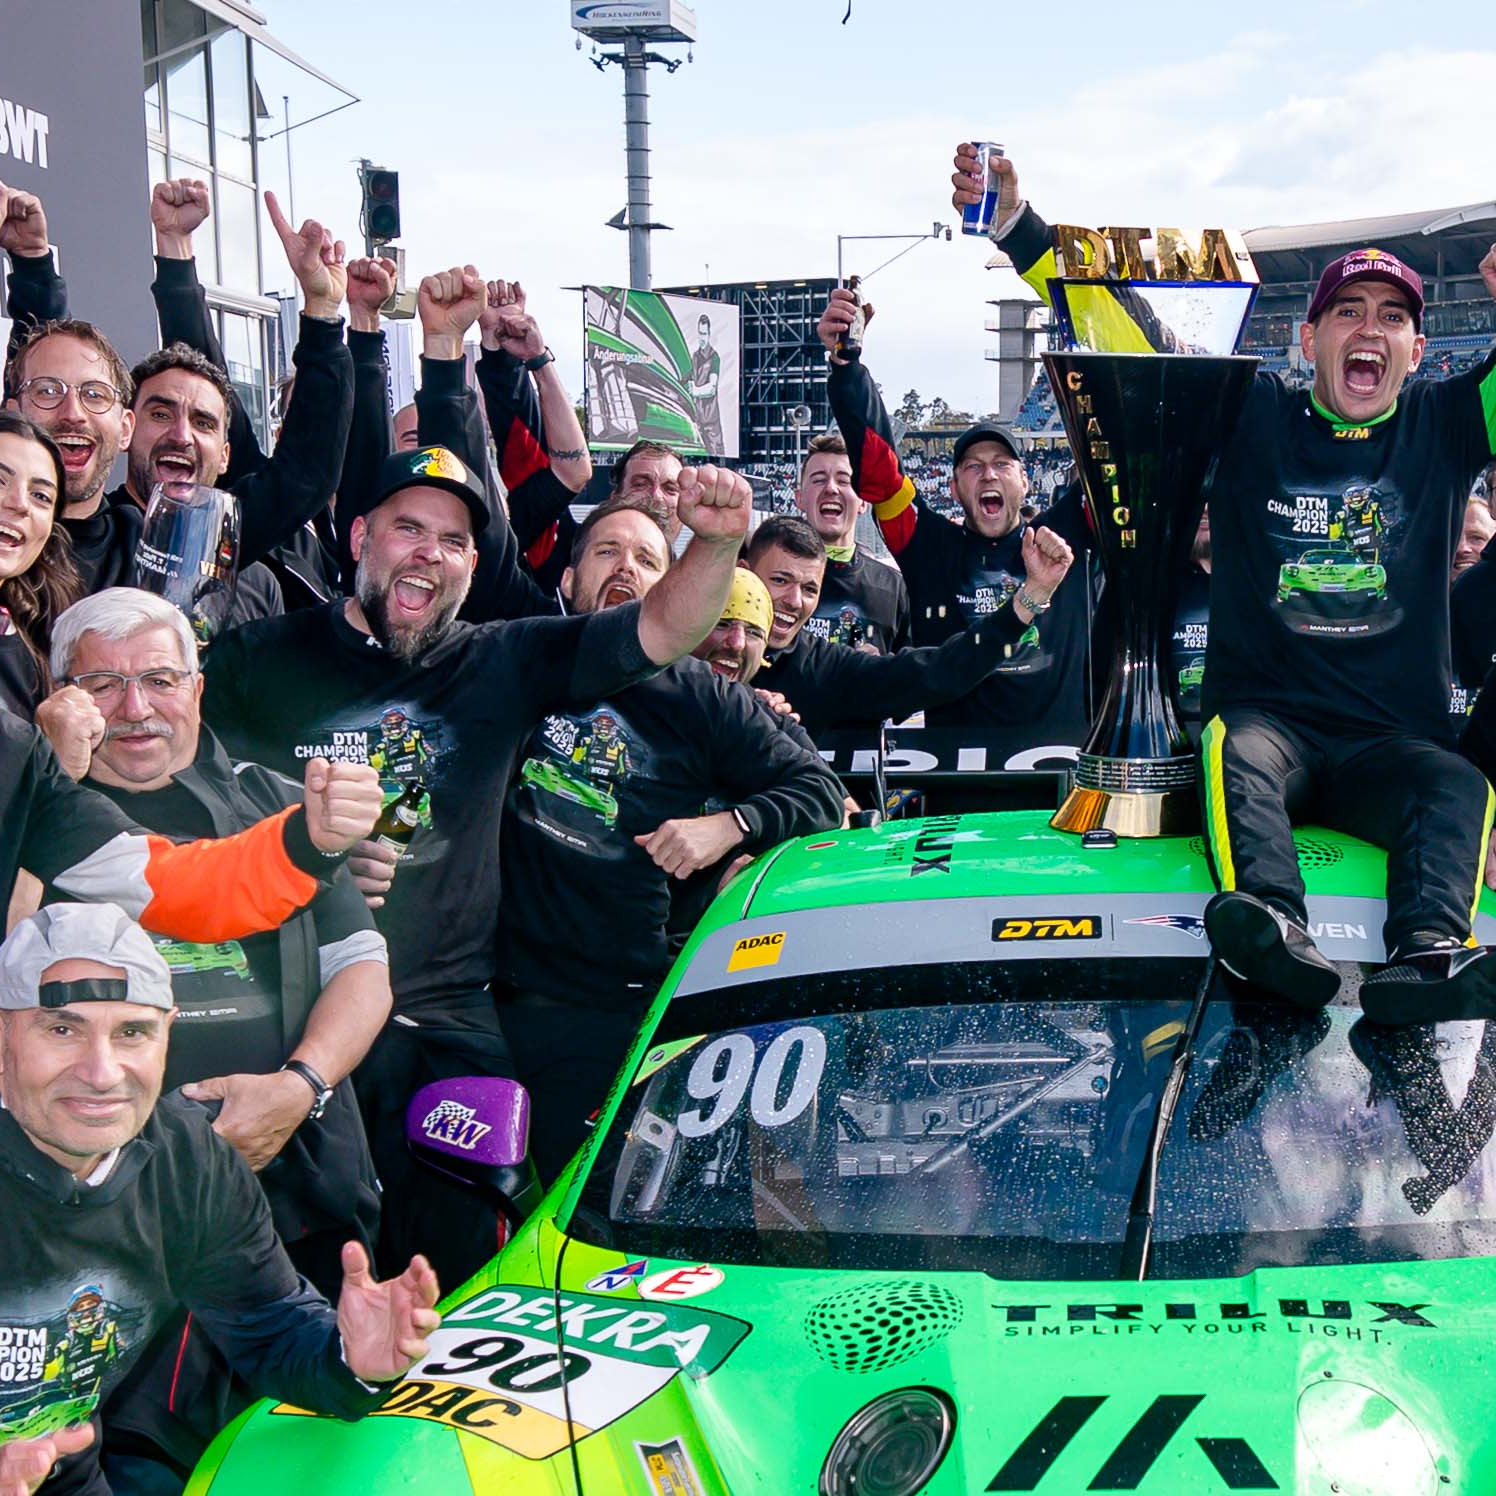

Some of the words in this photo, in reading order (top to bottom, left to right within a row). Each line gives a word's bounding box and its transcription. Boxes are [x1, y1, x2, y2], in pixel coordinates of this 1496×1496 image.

[1055, 223, 1248, 283] DTM
[1267, 499, 1328, 522] CHAMPION
[1295, 496, 1328, 511] DTM
[1292, 518, 1329, 534] 2025
[1308, 624, 1346, 633] MANTHEY
[332, 731, 368, 746] DTM
[294, 744, 368, 759] CHAMPION
[1000, 918, 1095, 940] DTM
[735, 933, 785, 953] ADAC
[675, 1026, 829, 1139] 90
[991, 1298, 1439, 1329] TRILUX
[457, 1288, 708, 1369] DEKRA
[1004, 1324, 1164, 1337] SIMPLIFY
[1182, 1322, 1268, 1334] YOUR
[1287, 1322, 1393, 1346] LIGHT.
[424, 1335, 592, 1395] 90
[381, 1381, 524, 1431] DAC
